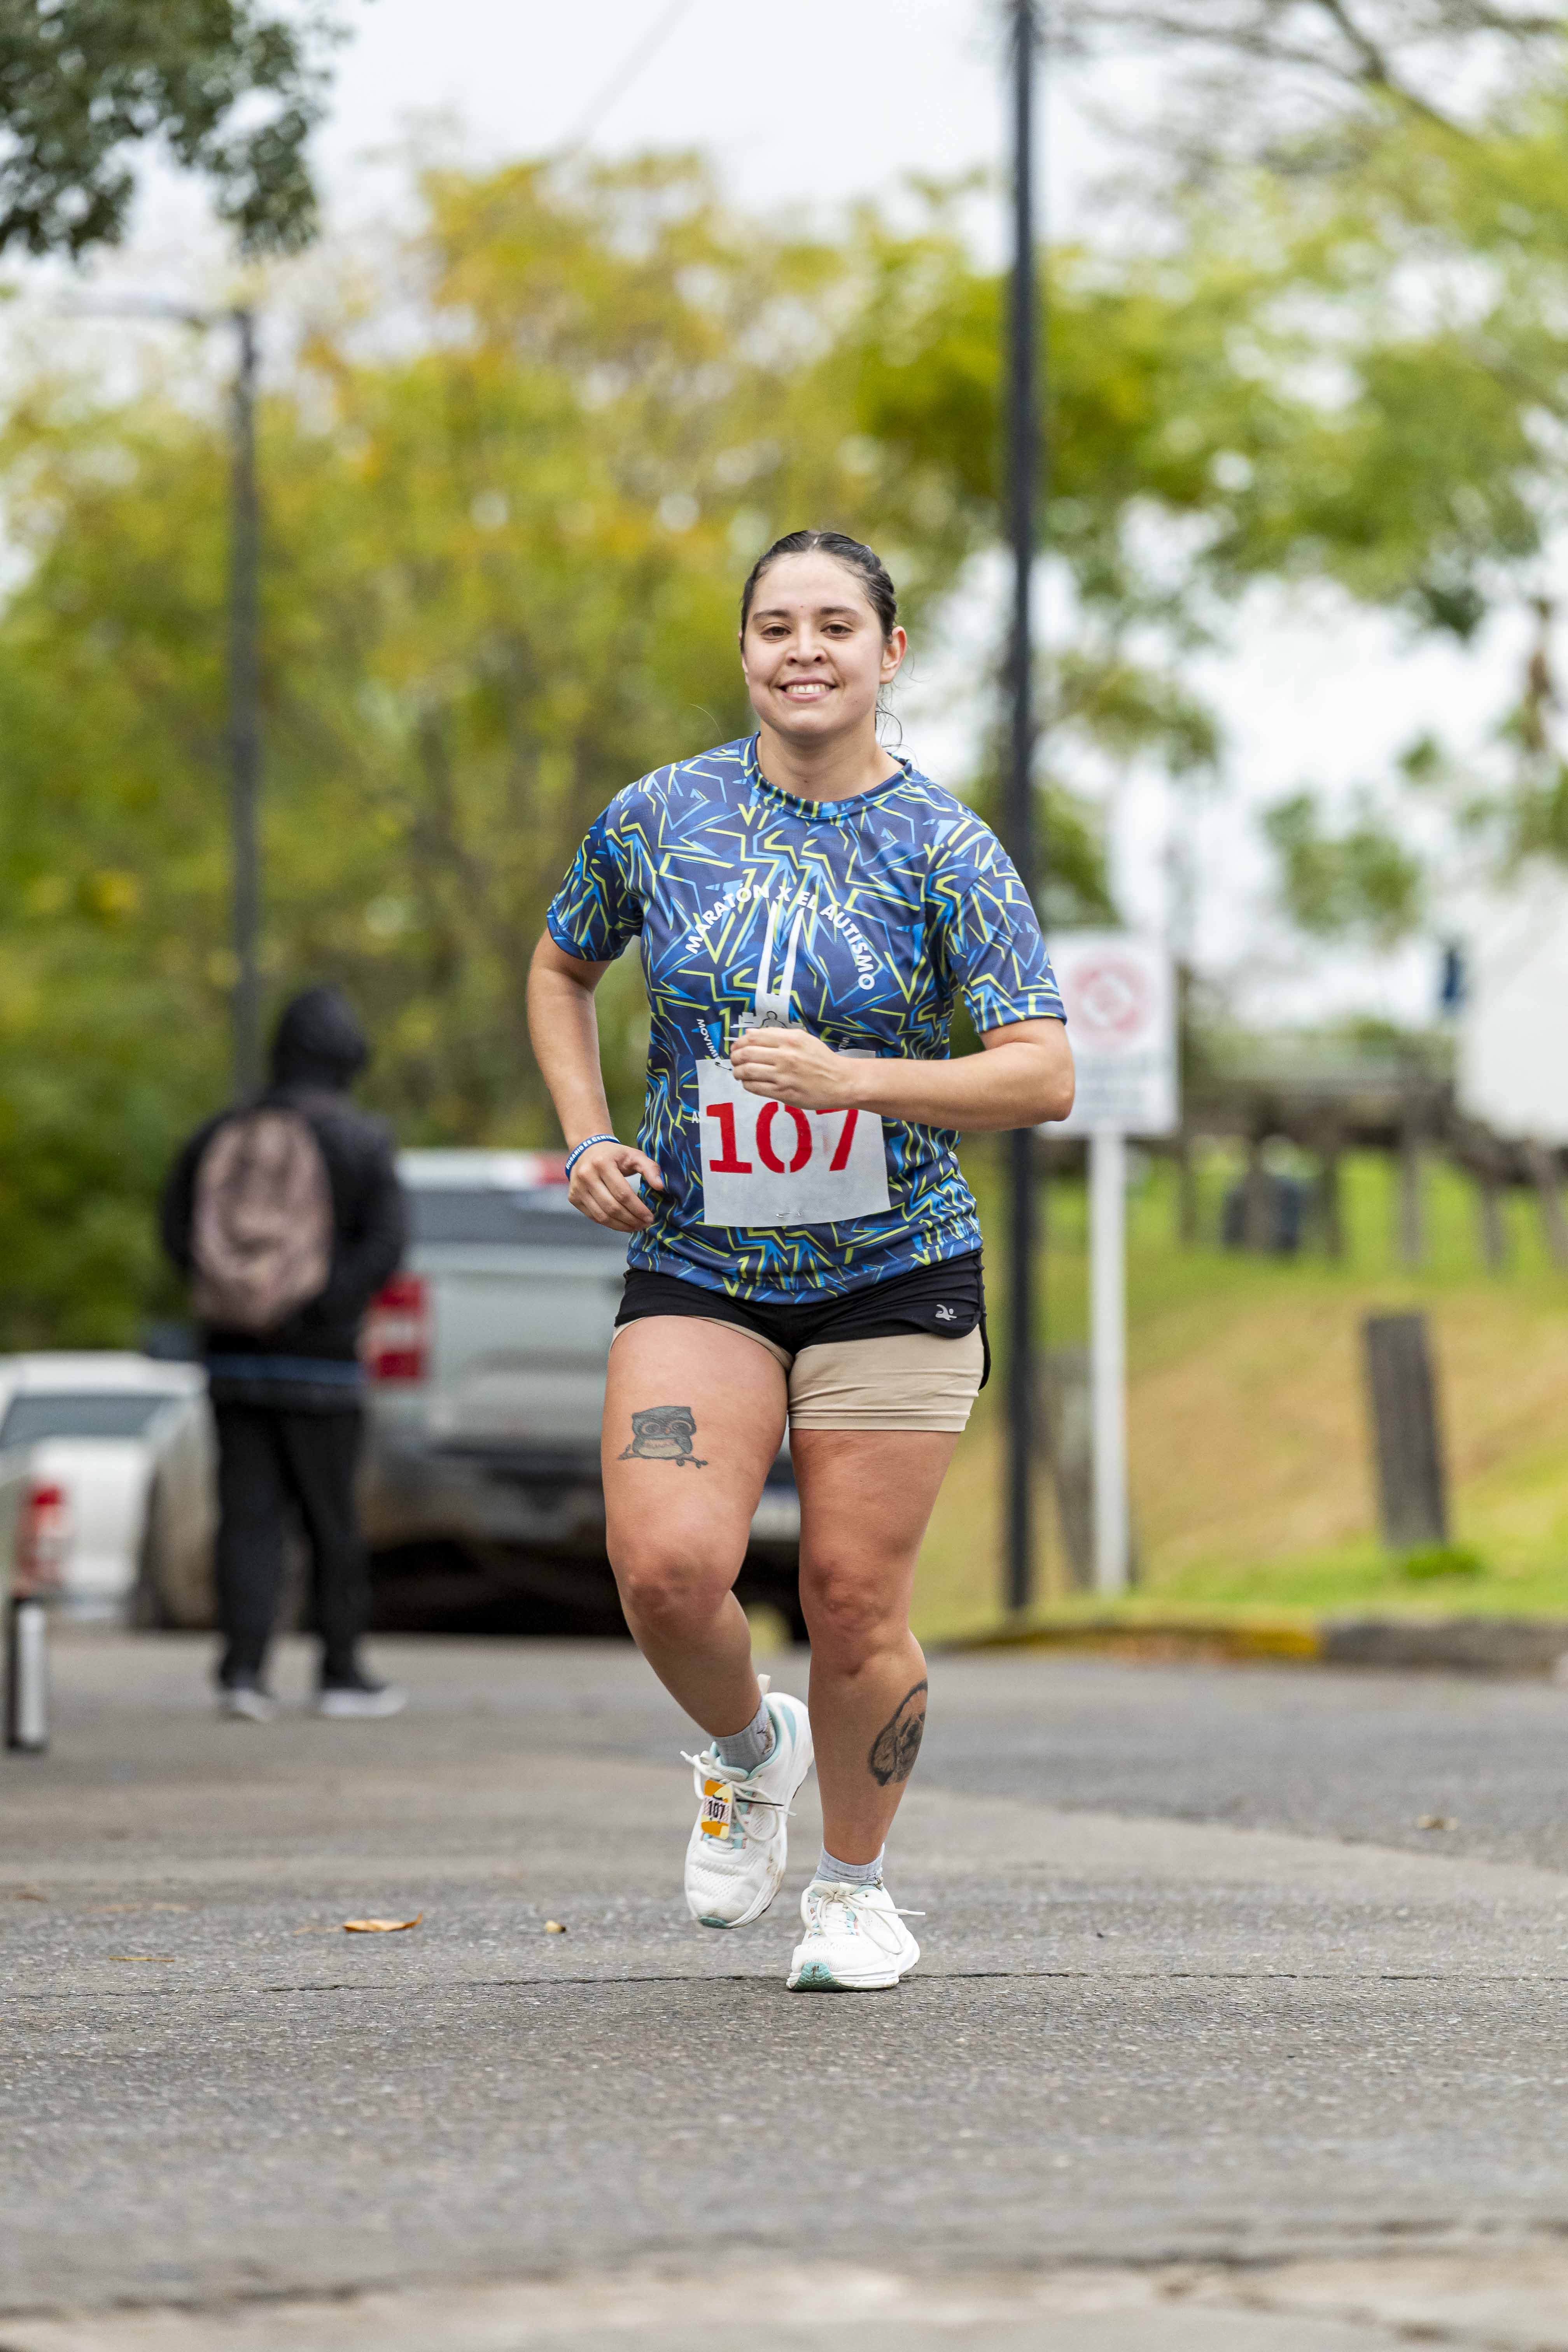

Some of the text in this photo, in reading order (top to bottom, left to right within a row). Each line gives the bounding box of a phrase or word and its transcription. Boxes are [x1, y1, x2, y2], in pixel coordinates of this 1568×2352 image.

[685, 883, 875, 990] MARATÓN X EL AUTISMO
[706, 1101, 859, 1174] 107
[709, 1800, 726, 1820] 107
